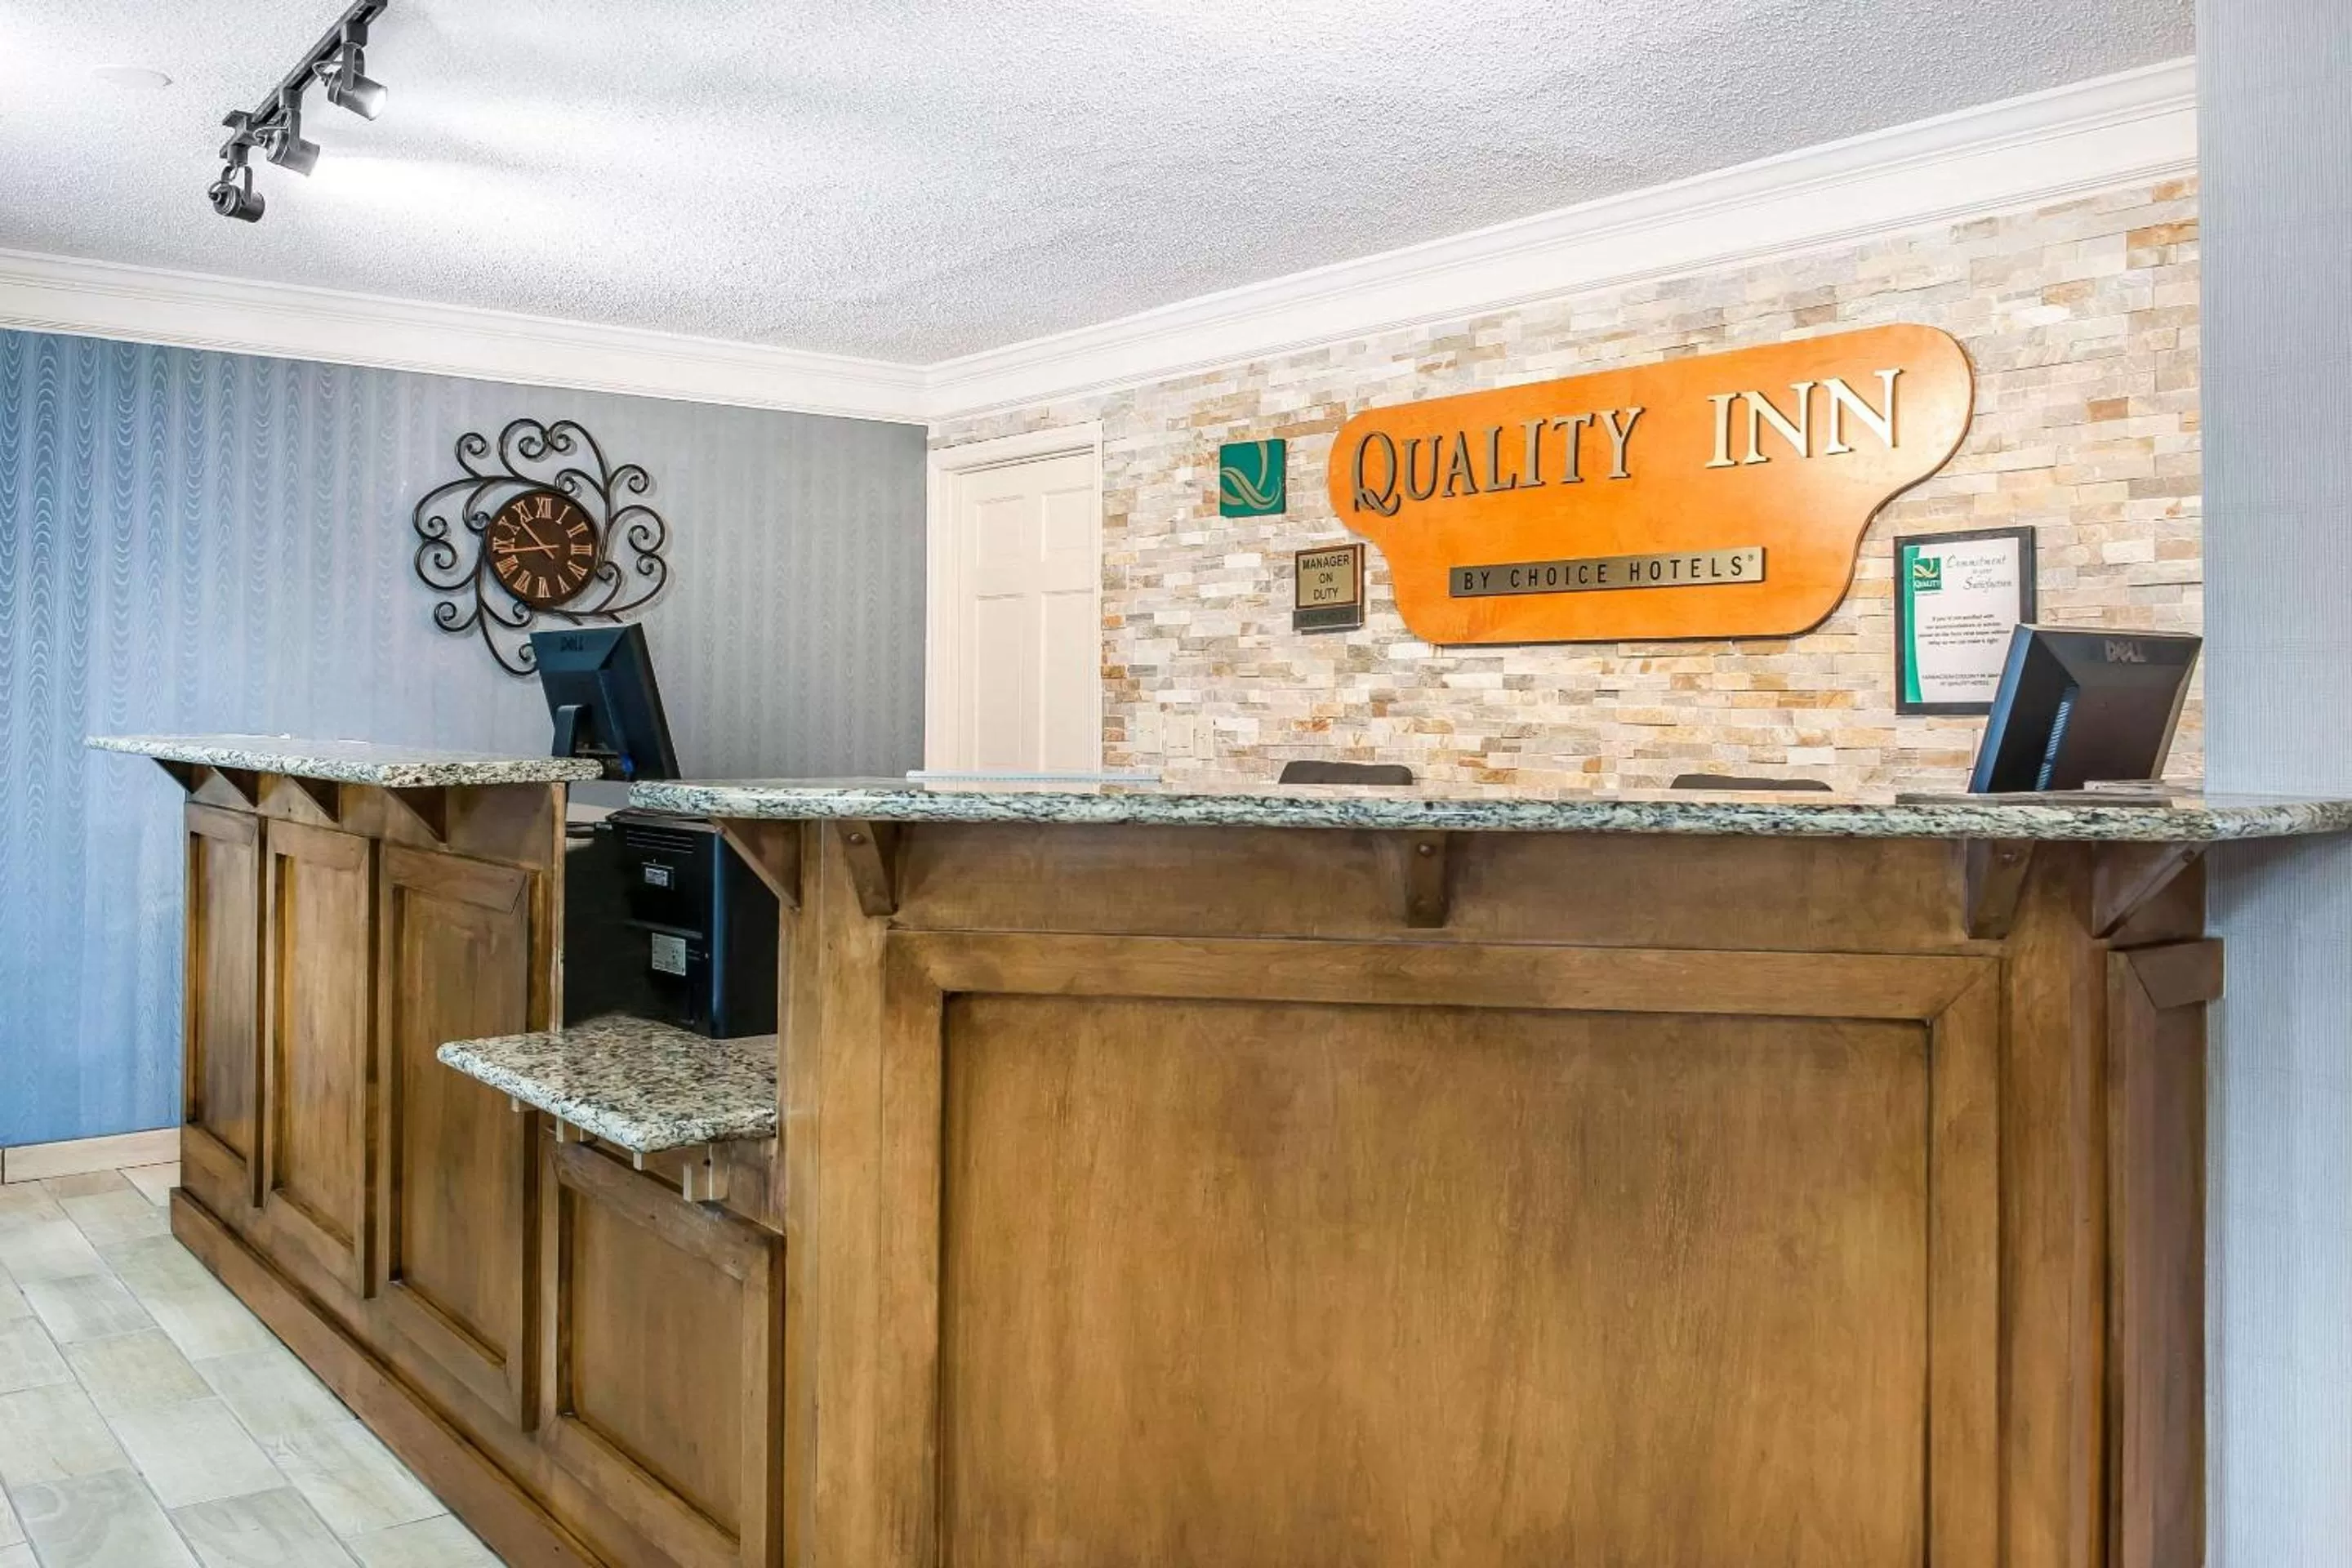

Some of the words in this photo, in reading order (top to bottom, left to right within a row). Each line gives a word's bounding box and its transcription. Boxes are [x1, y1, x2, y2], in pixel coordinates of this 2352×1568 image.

[1352, 407, 1646, 517] QUALITY
[1704, 368, 1905, 469] INN
[1303, 555, 1350, 570] MANAGER
[1319, 572, 1333, 584] ON
[1464, 572, 1490, 590] BY
[1510, 564, 1607, 589] CHOICE
[1313, 588, 1339, 600] DUTY
[2105, 639, 2146, 663] DELL
